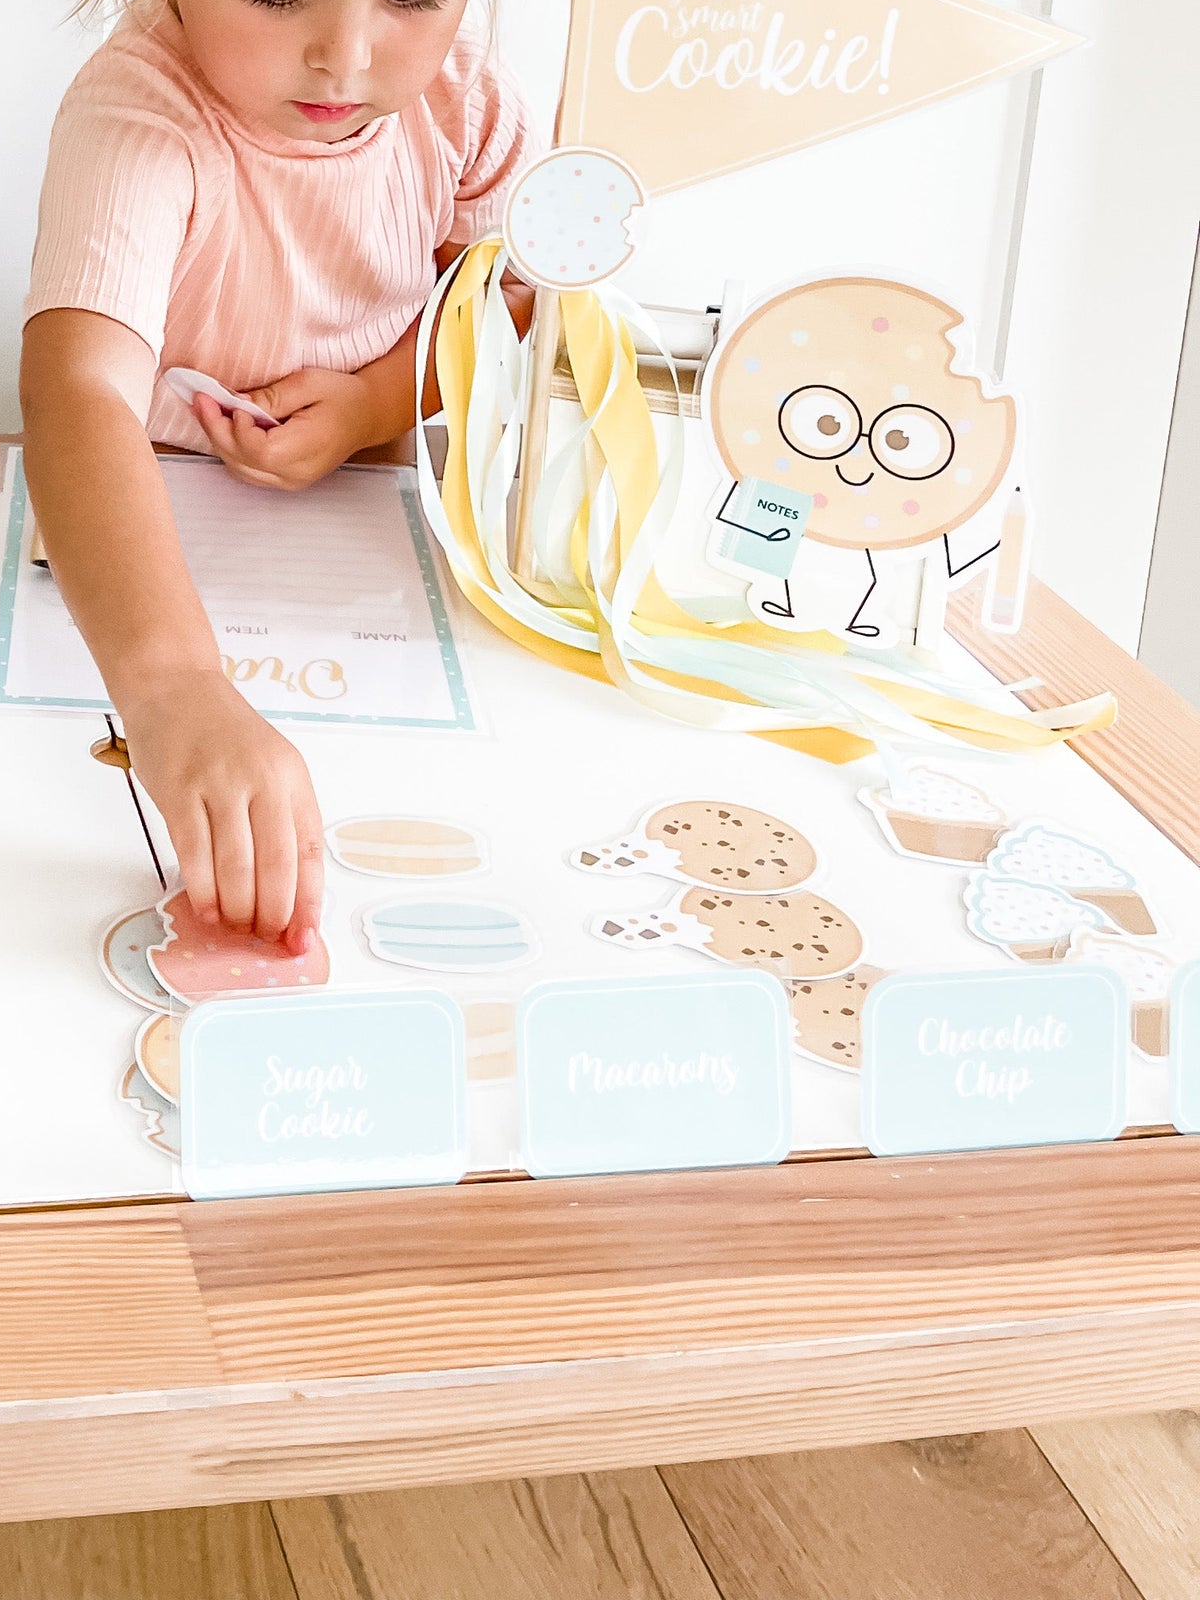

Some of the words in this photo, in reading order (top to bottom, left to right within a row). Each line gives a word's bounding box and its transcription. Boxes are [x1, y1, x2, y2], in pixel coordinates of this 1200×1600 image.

[615, 4, 899, 96] Cookie!
[757, 498, 799, 521] NOTES
[225, 625, 269, 636] ITEM
[351, 630, 408, 643] NAME
[917, 1014, 1072, 1059] Chocolate
[262, 1055, 369, 1108] Sugar
[567, 1049, 740, 1096] Macarons
[954, 1059, 1034, 1104] Chip
[257, 1101, 374, 1143] Cookie
